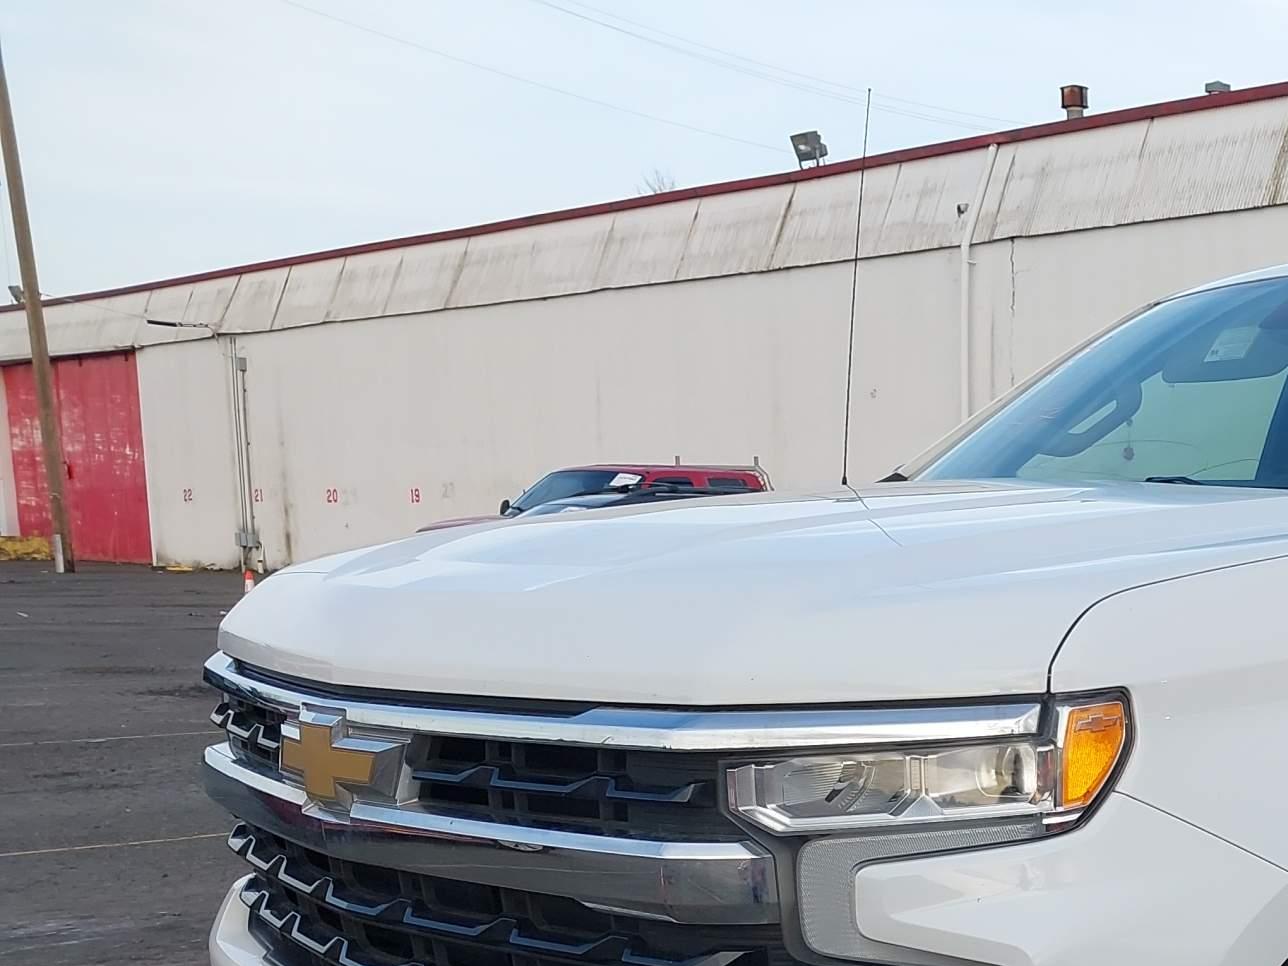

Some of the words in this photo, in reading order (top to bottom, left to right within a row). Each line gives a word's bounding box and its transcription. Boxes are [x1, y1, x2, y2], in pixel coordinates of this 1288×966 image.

[183, 488, 193, 502] 22
[254, 488, 264, 502] 21
[326, 488, 338, 503] 20
[410, 488, 421, 503] 19
